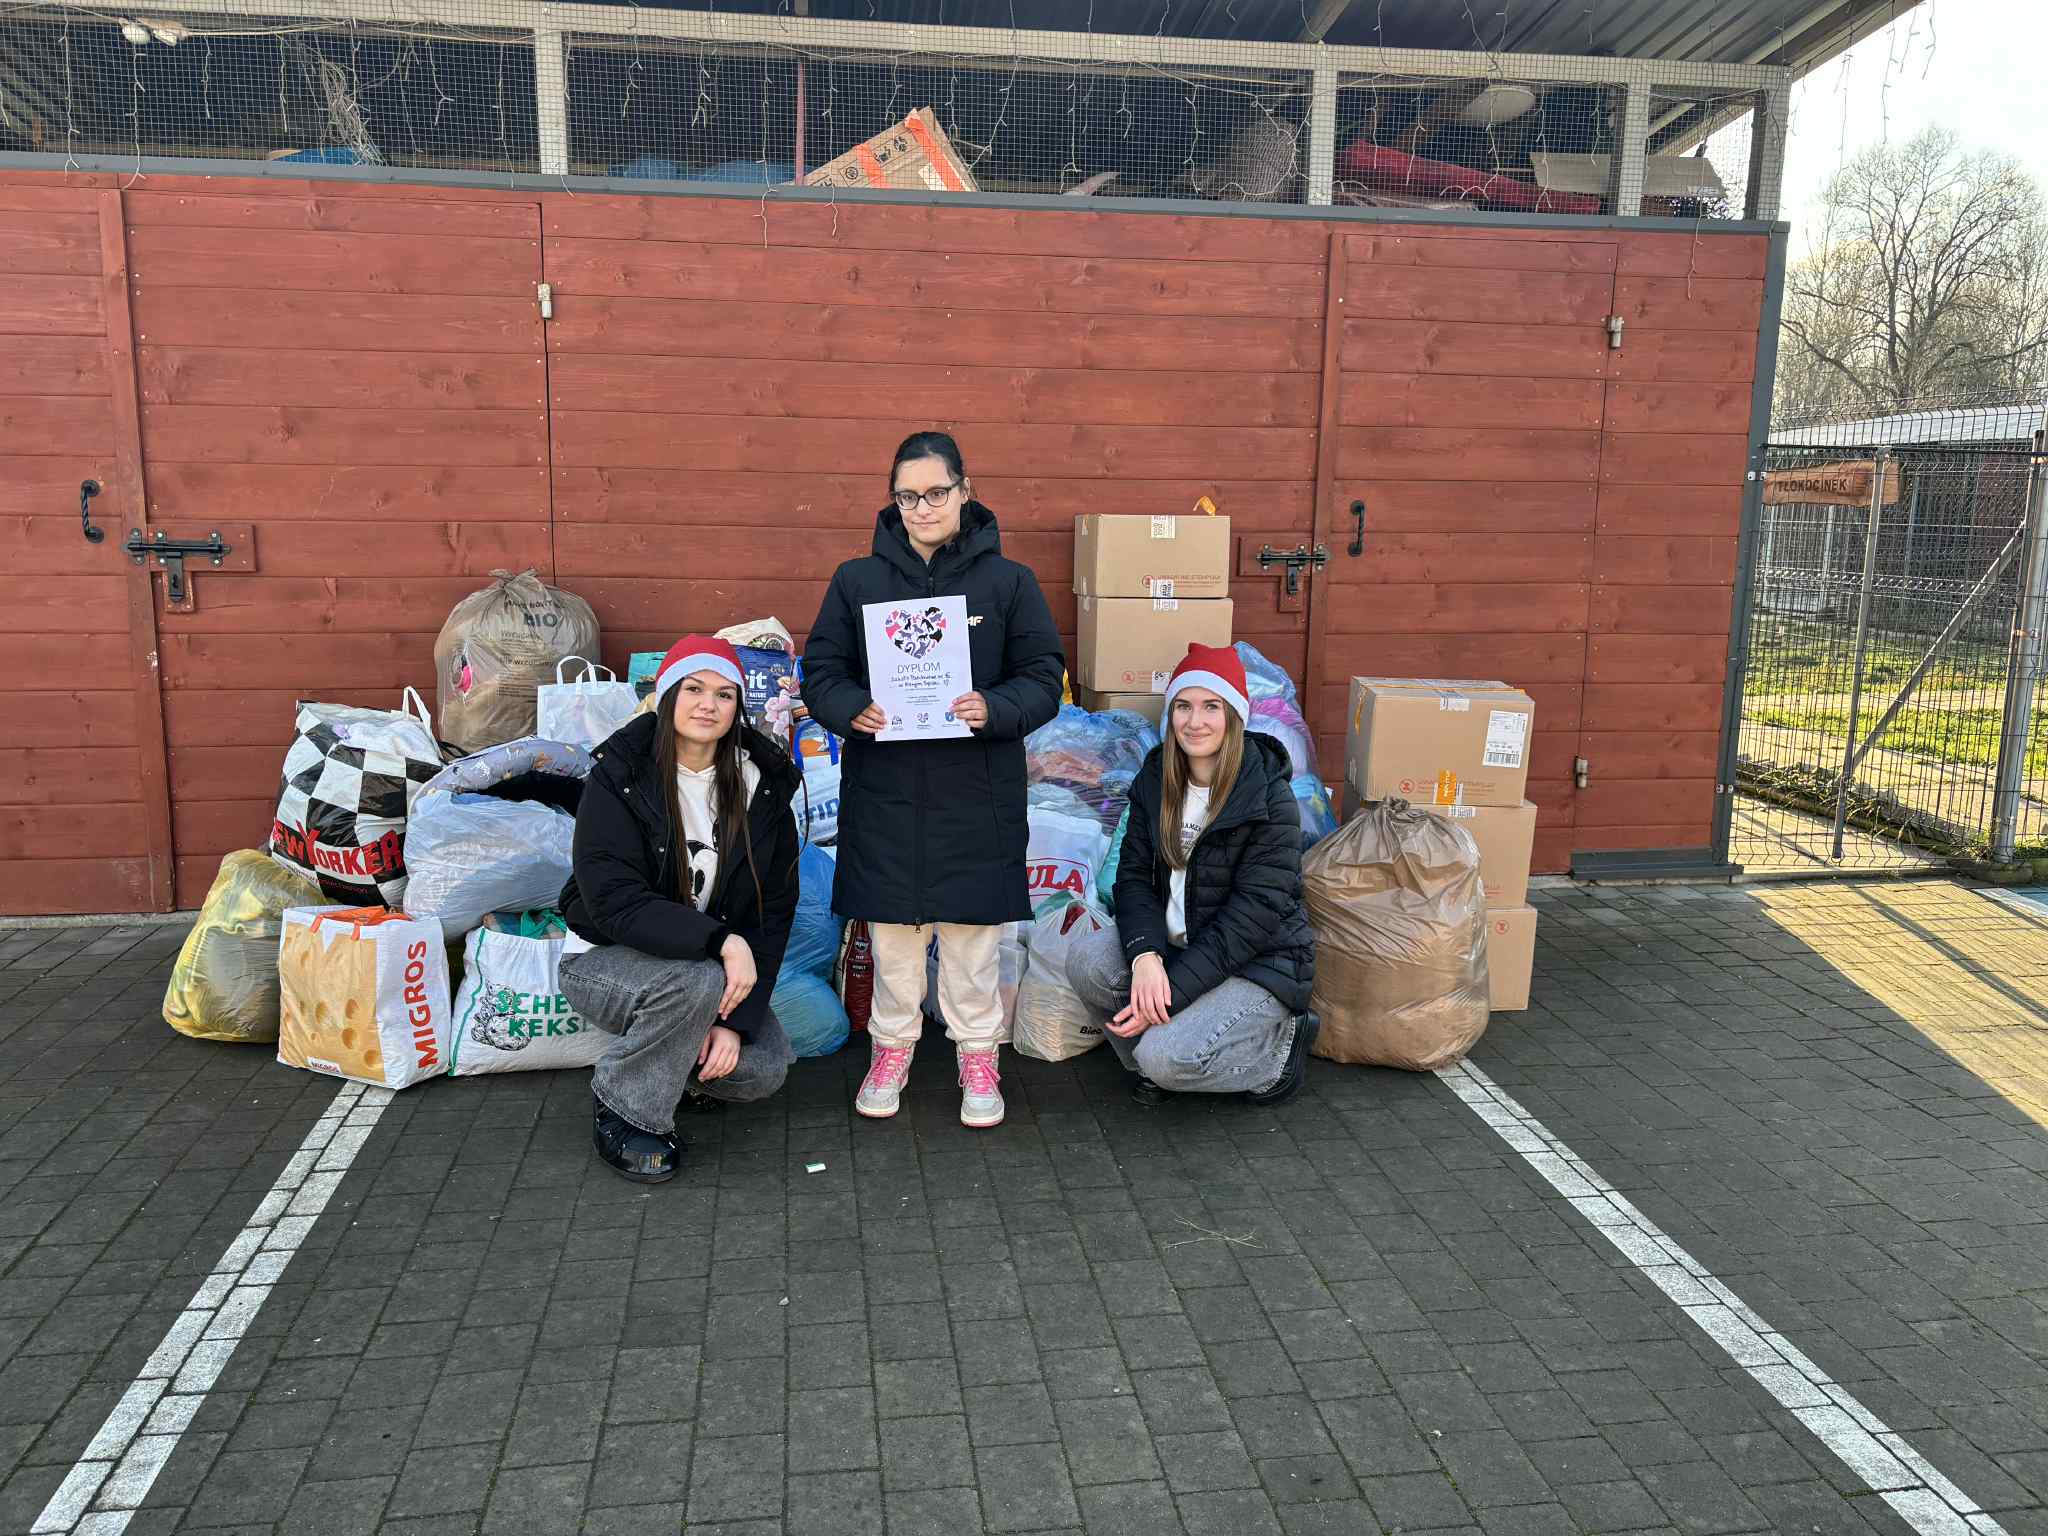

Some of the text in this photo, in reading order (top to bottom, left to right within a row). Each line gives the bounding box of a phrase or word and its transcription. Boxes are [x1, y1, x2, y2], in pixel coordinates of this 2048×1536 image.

[897, 662, 941, 674] DYPLOM
[295, 819, 404, 876] YORKER
[404, 941, 439, 1069] MIGROS
